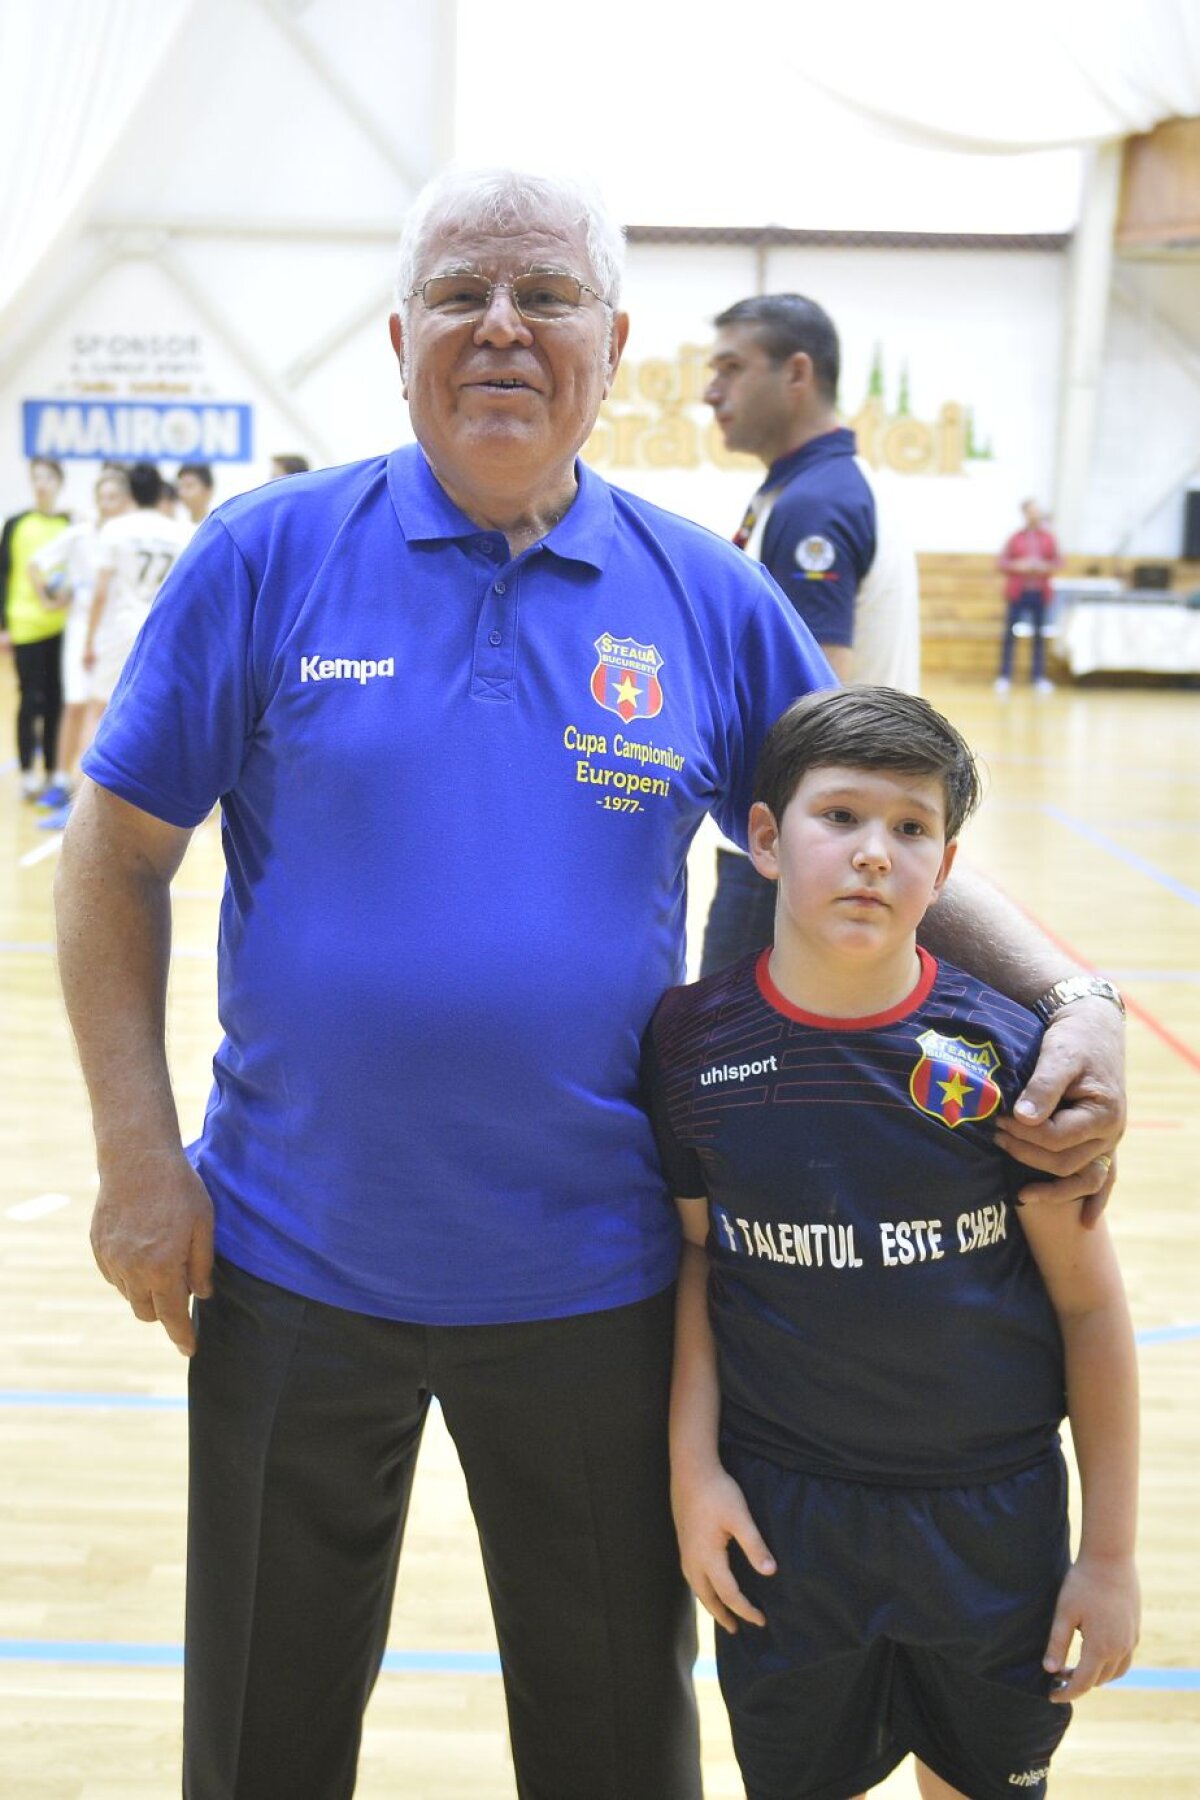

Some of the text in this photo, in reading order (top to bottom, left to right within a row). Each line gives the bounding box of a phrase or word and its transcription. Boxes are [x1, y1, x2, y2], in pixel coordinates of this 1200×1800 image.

[36, 405, 241, 457] MAIRON
[300, 655, 395, 685] Kempa
[563, 725, 685, 773] Cupa Campionilor
[576, 760, 670, 797] Europeni
[700, 1055, 778, 1086] uhlsport
[735, 1217, 863, 1269] TALENTUL
[880, 1219, 945, 1266] ESTE
[956, 1200, 1007, 1253] CHEIA
